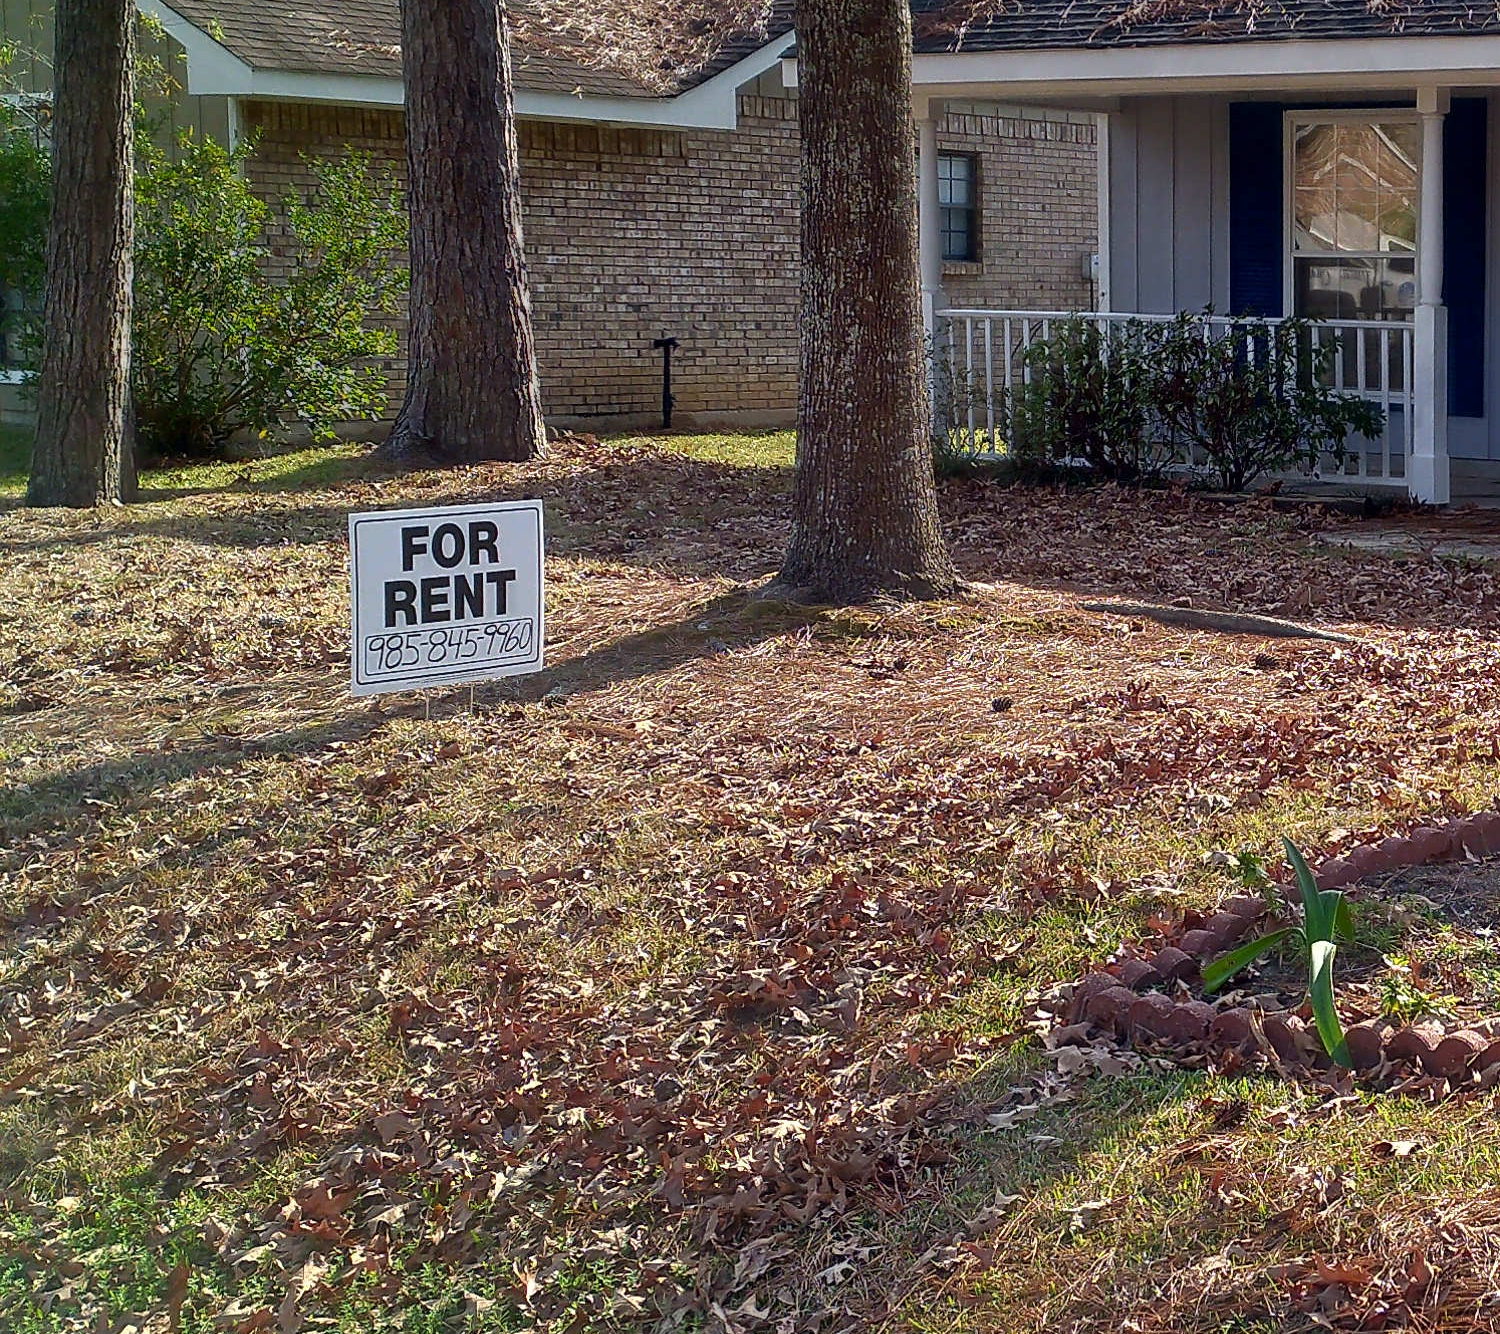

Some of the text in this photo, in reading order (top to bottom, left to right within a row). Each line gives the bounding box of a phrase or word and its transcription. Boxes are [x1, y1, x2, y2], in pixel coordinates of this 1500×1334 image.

[401, 521, 499, 571] FOR
[384, 570, 516, 628] RENT
[368, 623, 532, 669] 985-845-9960
